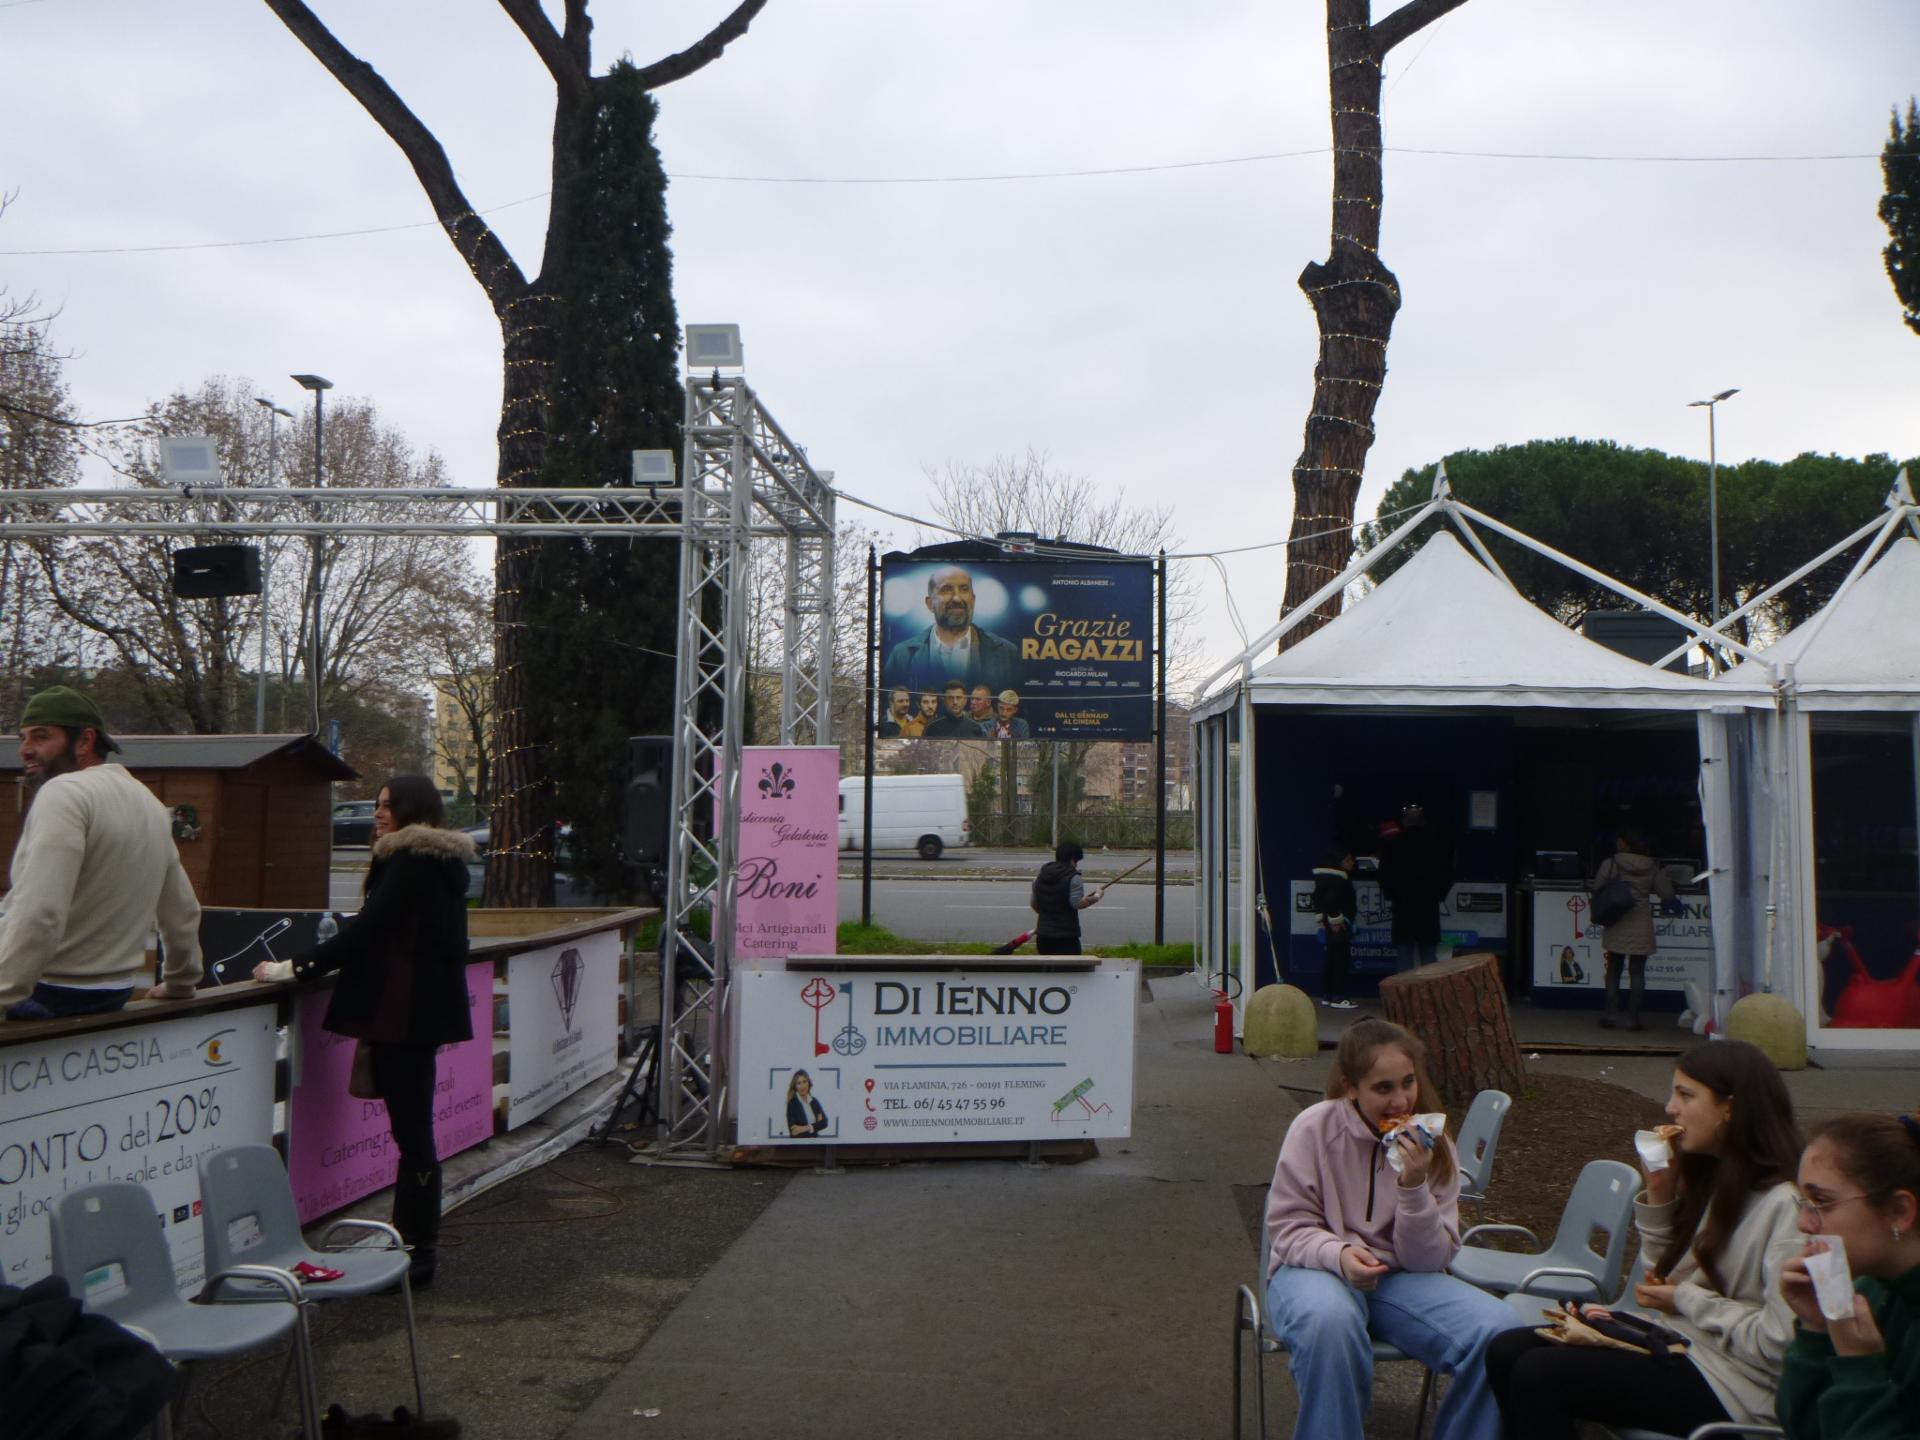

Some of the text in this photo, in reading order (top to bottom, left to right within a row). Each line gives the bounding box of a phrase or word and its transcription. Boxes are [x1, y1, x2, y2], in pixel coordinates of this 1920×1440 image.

[1034, 613, 1131, 638] Grazie
[1022, 638, 1143, 661] RAGAZZI
[739, 811, 785, 825] sticceria
[771, 824, 829, 848] Gelateria
[737, 857, 821, 900] Boni
[757, 922, 827, 936] Artigianali
[743, 937, 799, 952] Catering
[876, 1026, 1067, 1047] IMMOBILIARE
[0, 1037, 164, 1096] ICA CASSIA
[883, 1081, 900, 1090] VIA
[901, 1081, 950, 1091] FLAMINIA,
[951, 1081, 968, 1091] 726
[976, 1080, 1001, 1090] 00191
[1004, 1079, 1046, 1090] FLEMING
[913, 1098, 936, 1111] 06/
[937, 1099, 954, 1110] 45
[955, 1099, 971, 1110] 47
[973, 1098, 988, 1109] 55
[990, 1097, 1006, 1109] 96
[0, 1086, 222, 1186] ONTO del 20%
[321, 1133, 386, 1170] Catering
[5, 1191, 27, 1236] gli
[163, 1161, 172, 1176] e
[175, 1145, 193, 1171] da
